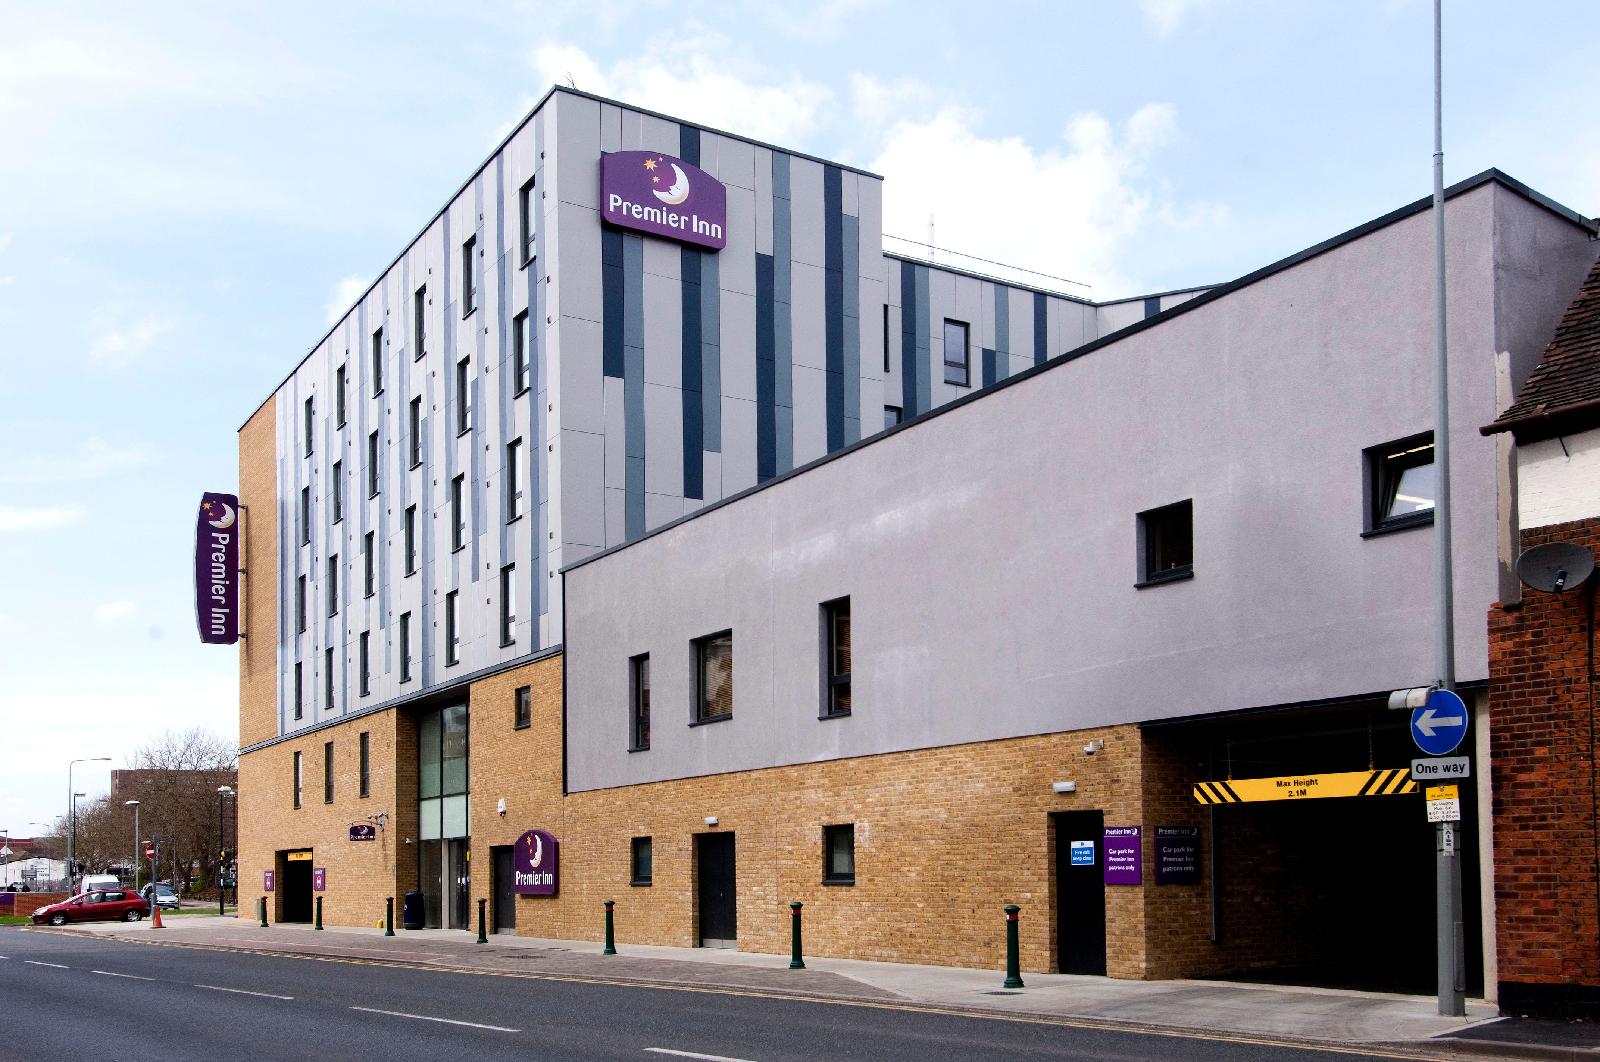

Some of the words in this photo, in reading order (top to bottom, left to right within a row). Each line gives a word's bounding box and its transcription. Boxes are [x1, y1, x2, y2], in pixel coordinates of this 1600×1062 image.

[609, 194, 689, 230] Premier
[692, 215, 722, 239] Inn
[212, 532, 230, 605] Premier
[212, 608, 230, 635] Inn
[1415, 764, 1438, 774] One
[1442, 763, 1465, 774] way
[1276, 780, 1292, 788] Max
[1293, 778, 1318, 787] Height
[1288, 789, 1307, 797] 2.1M
[516, 871, 542, 885] Premier
[542, 870, 553, 885] Inn
